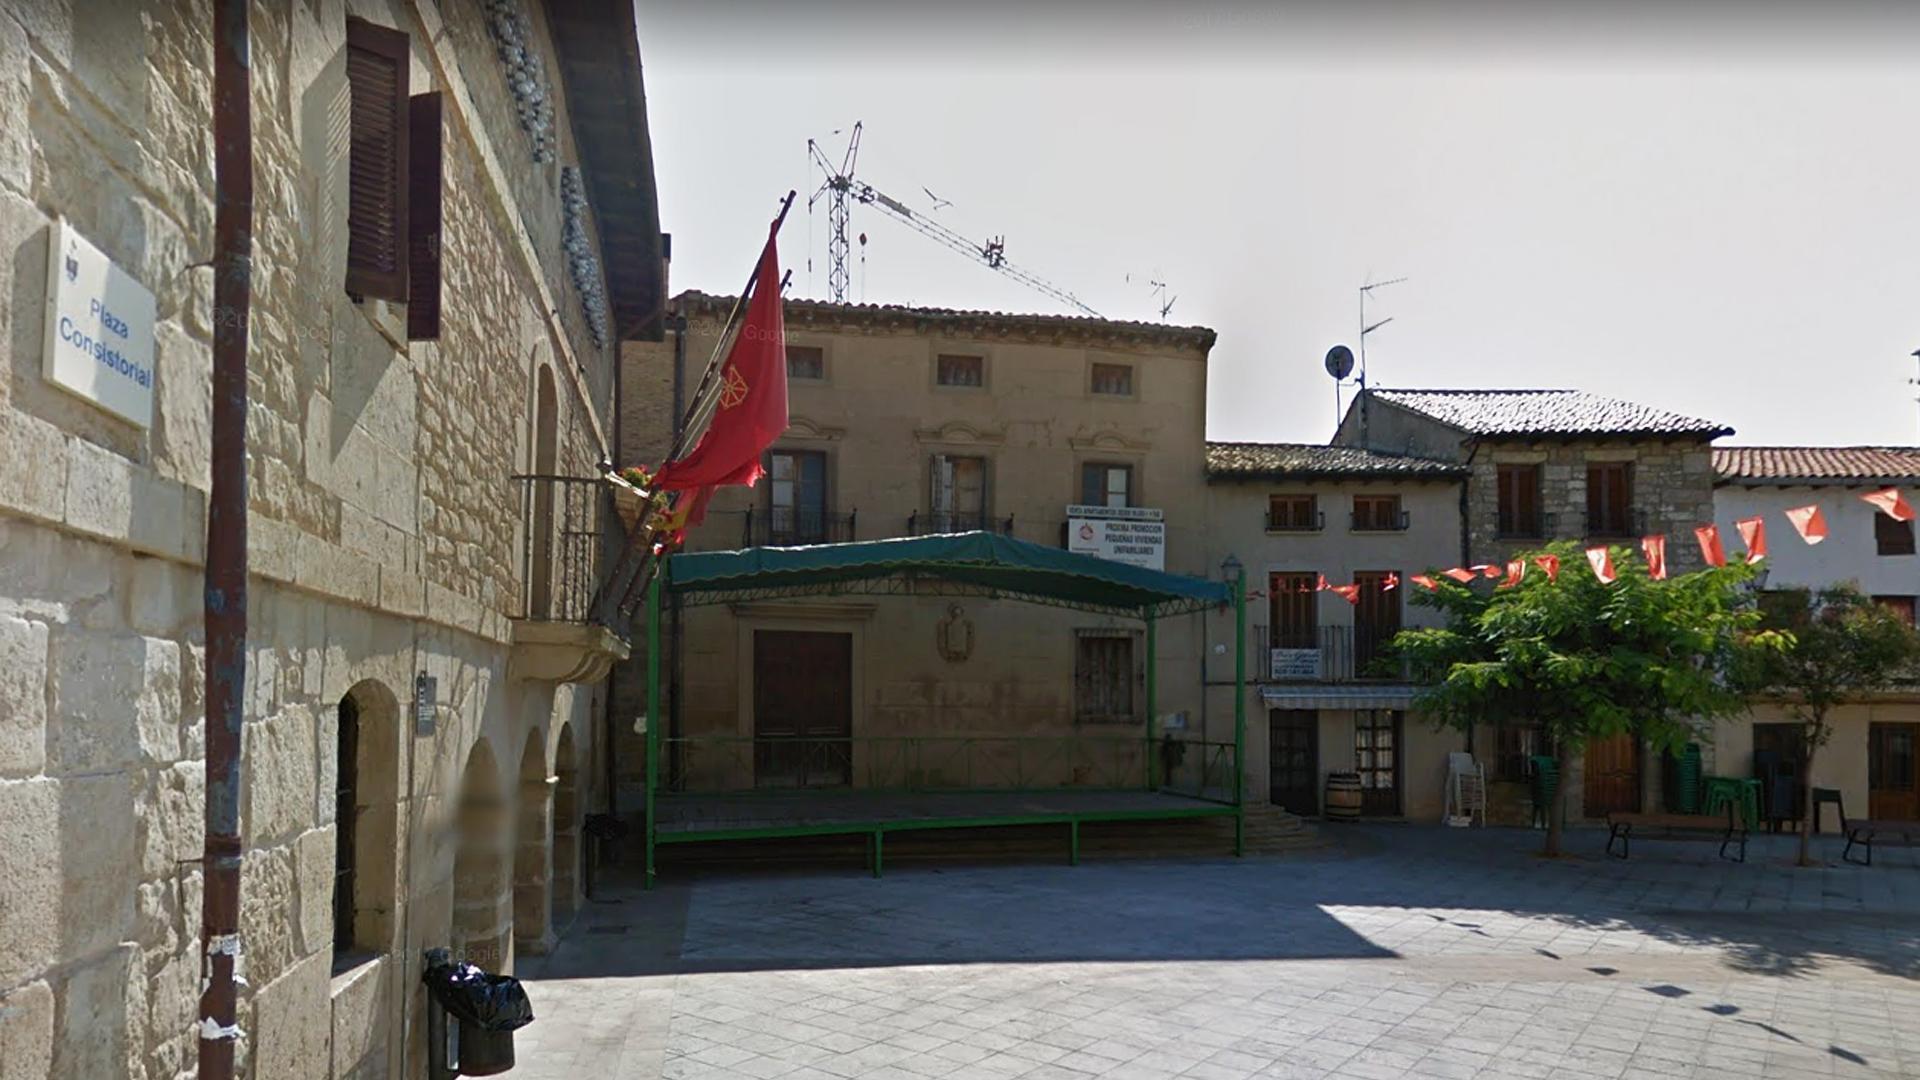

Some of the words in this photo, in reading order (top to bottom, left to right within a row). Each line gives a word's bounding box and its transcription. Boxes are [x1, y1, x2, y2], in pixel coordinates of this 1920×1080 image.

[90, 298, 129, 340] Plaza
[59, 316, 151, 389] Consistorial
[1131, 524, 1162, 533] PROMOCION
[1134, 535, 1162, 545] VIVIENDAS
[1113, 545, 1154, 555] UNIFAMILIARES
